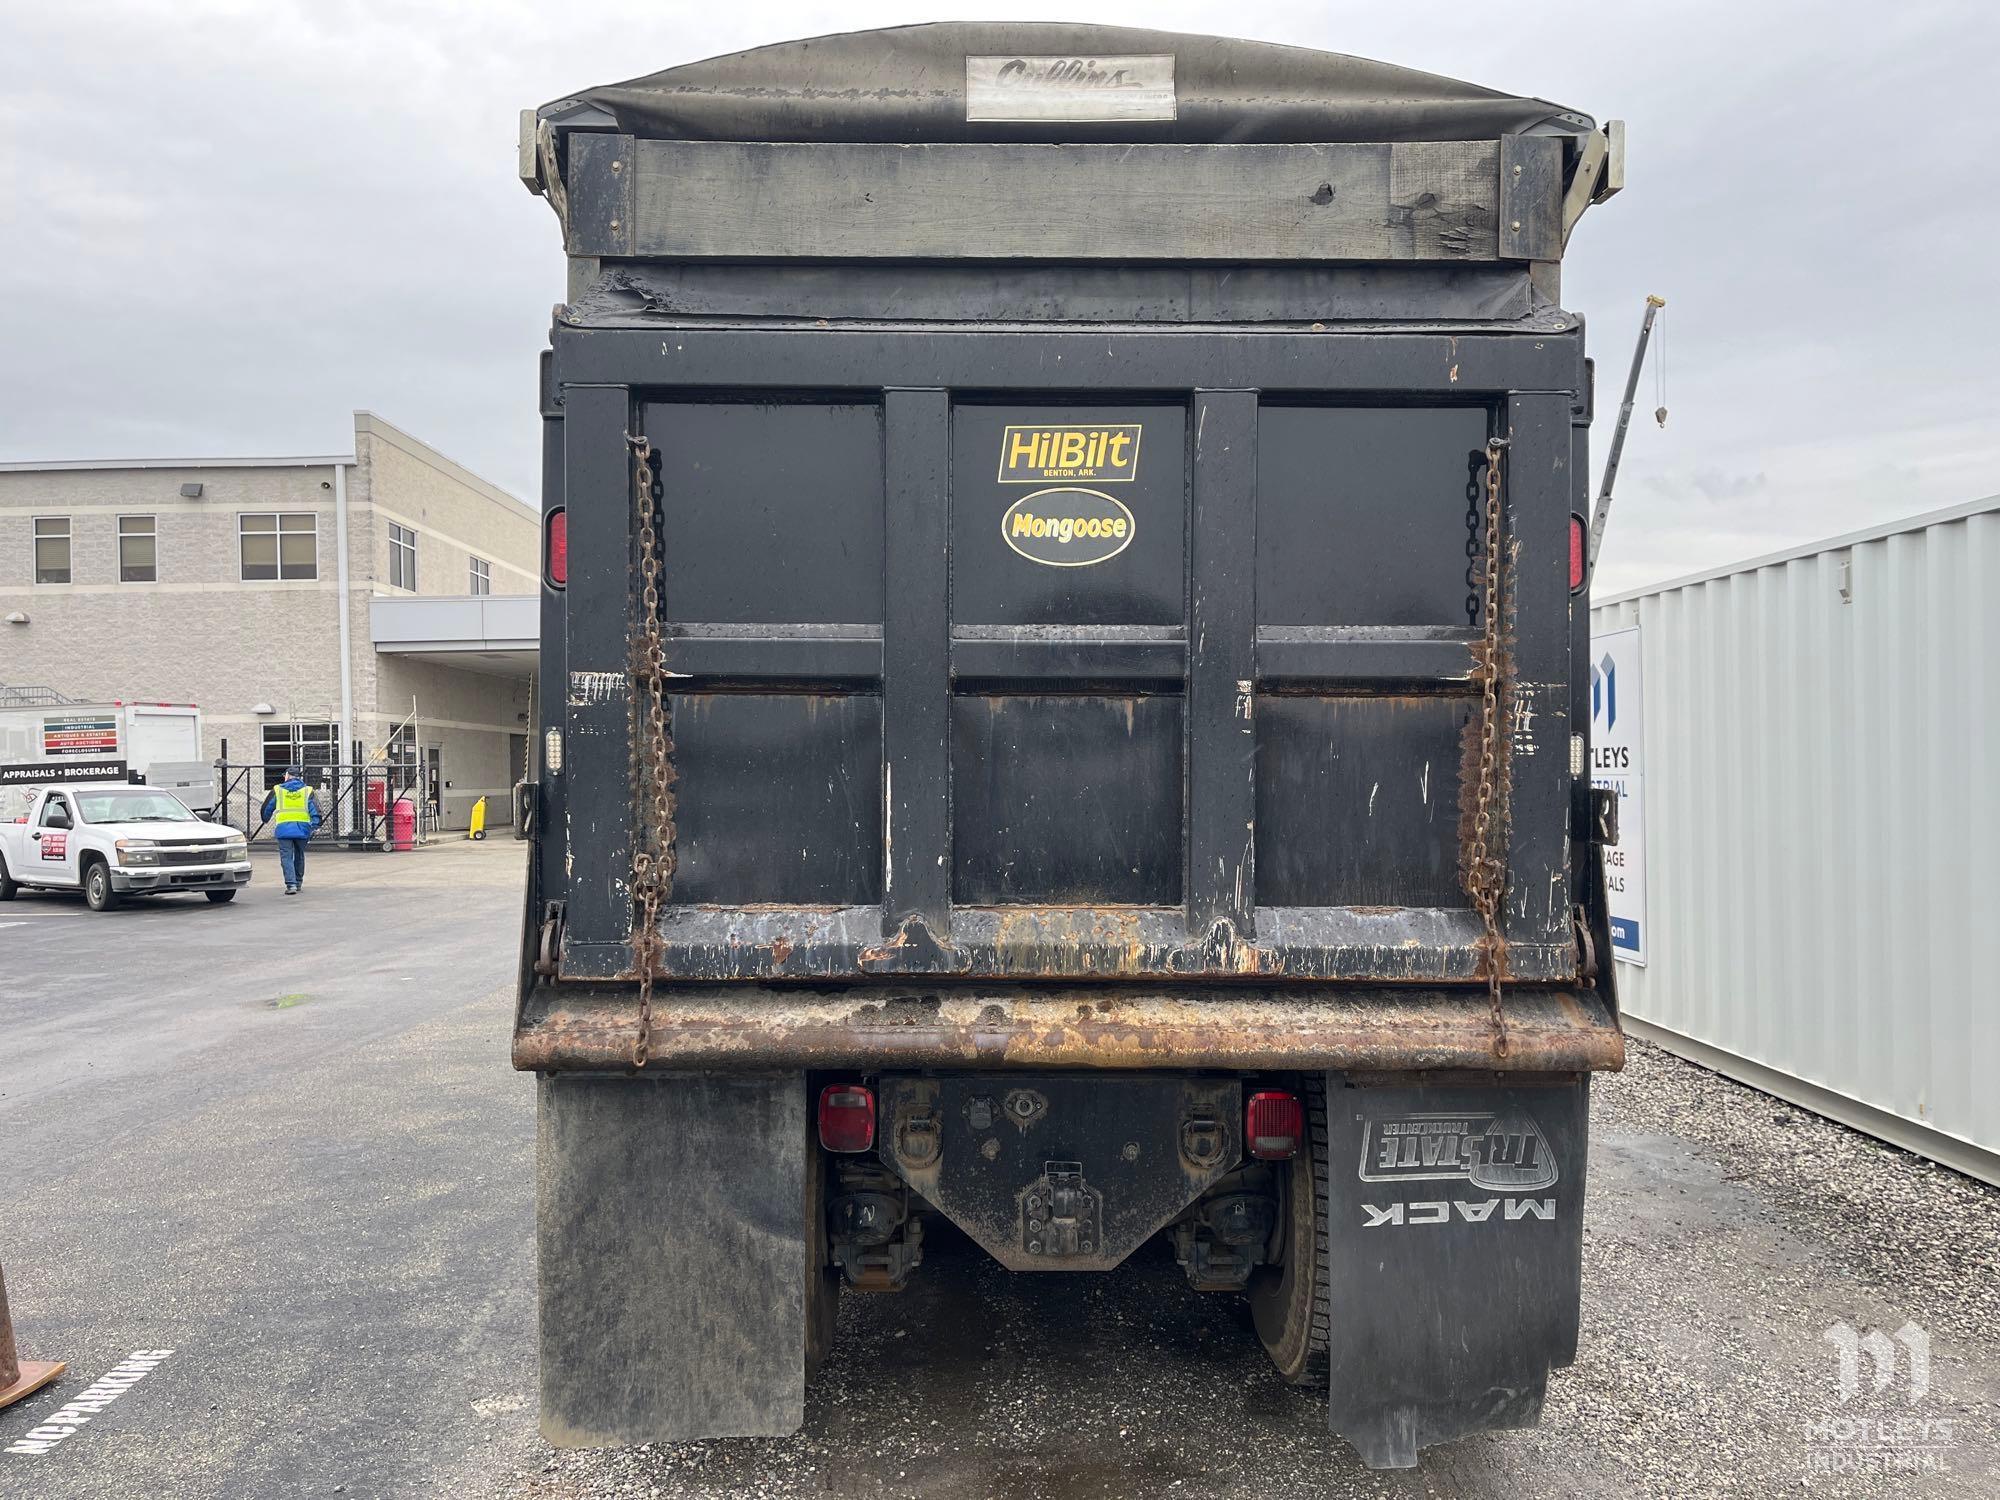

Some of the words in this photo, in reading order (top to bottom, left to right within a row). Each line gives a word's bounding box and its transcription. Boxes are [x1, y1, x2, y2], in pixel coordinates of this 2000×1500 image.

[1008, 431, 1131, 469] HilBilt
[1078, 468, 1097, 476] ARK.
[1011, 513, 1127, 543] Mongoose
[3, 769, 55, 779] APPRAISALS
[64, 766, 119, 776] BROKERAGE
[1605, 851, 1625, 867] AGE
[1606, 876, 1625, 893] ALS
[1360, 1199, 1556, 1227] MACK
[3, 1425, 77, 1455] NO
[42, 1349, 176, 1425] PARKING
